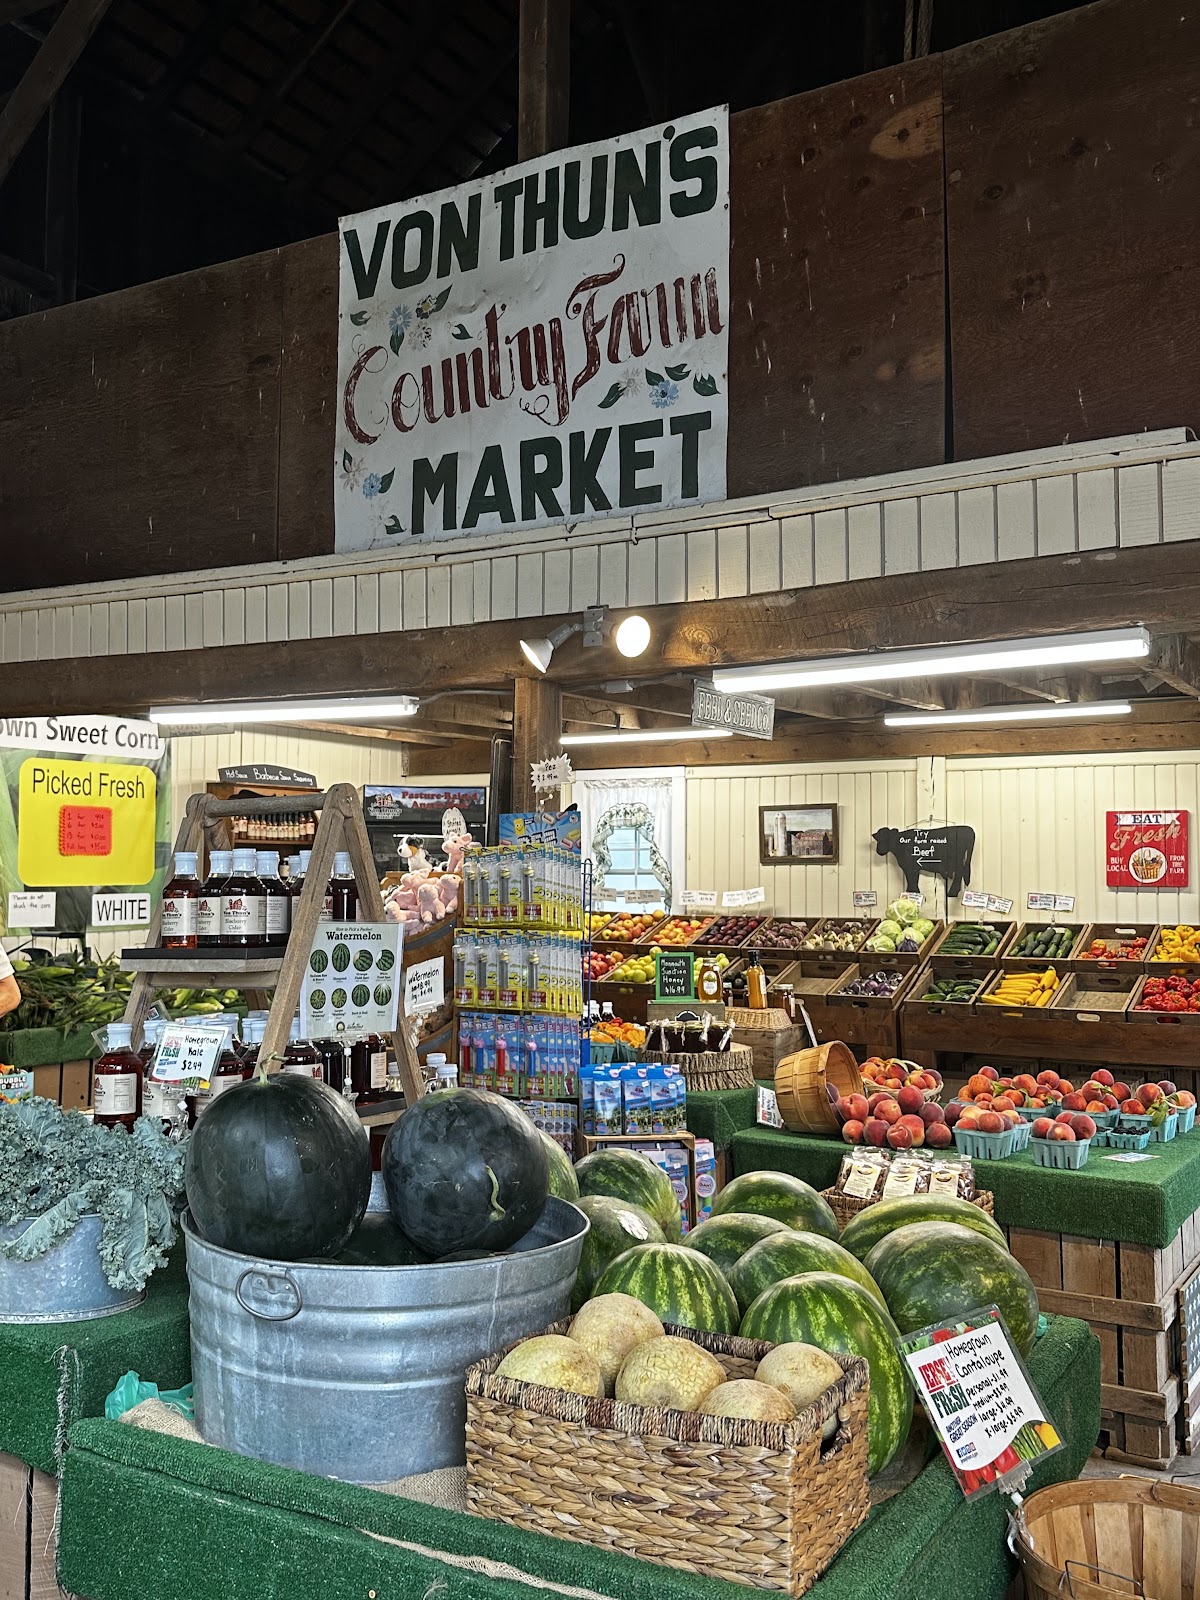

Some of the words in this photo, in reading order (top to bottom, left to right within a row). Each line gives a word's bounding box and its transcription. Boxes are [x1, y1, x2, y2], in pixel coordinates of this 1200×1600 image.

[343, 192, 482, 300] VON
[494, 125, 718, 261] THUN'S
[343, 303, 570, 446] Country
[565, 253, 725, 402] Farm
[411, 410, 712, 535] MARKET
[698, 692, 723, 721] FEED
[724, 699, 732, 723] &
[733, 700, 757, 728] SEED
[757, 706, 770, 731] Co.
[46, 718, 108, 745] Sweet
[115, 724, 159, 750] Corn
[33, 768, 92, 796] Picked
[99, 773, 145, 799] Fresh
[1132, 814, 1162, 824] EAT
[914, 830, 929, 838] Try
[1110, 820, 1182, 851] Fresh
[911, 846, 935, 857] Beef
[97, 899, 147, 921] WHITE
[326, 931, 382, 941] Watermelon
[456, 936, 474, 945] PEZ
[478, 937, 496, 945] PEZ
[499, 937, 518, 945] PEZ
[529, 938, 548, 946] PEZ
[661, 959, 685, 967] Monmouth
[663, 975, 684, 984] Honey
[665, 986, 685, 994] $16.99
[476, 1021, 494, 1030] PEZ
[497, 1021, 516, 1031] PEZ
[527, 1023, 546, 1032] PEZ
[185, 1035, 219, 1047] Homegrown
[188, 1047, 203, 1057] Kale
[944, 1334, 992, 1359] Homegrown
[955, 1350, 1005, 1378] Cantaloupe
[918, 1355, 958, 1391] JERSEY
[931, 1383, 971, 1418] FRESH
[949, 1426, 964, 1443] GREAT
[961, 1413, 978, 1433] SEASON
